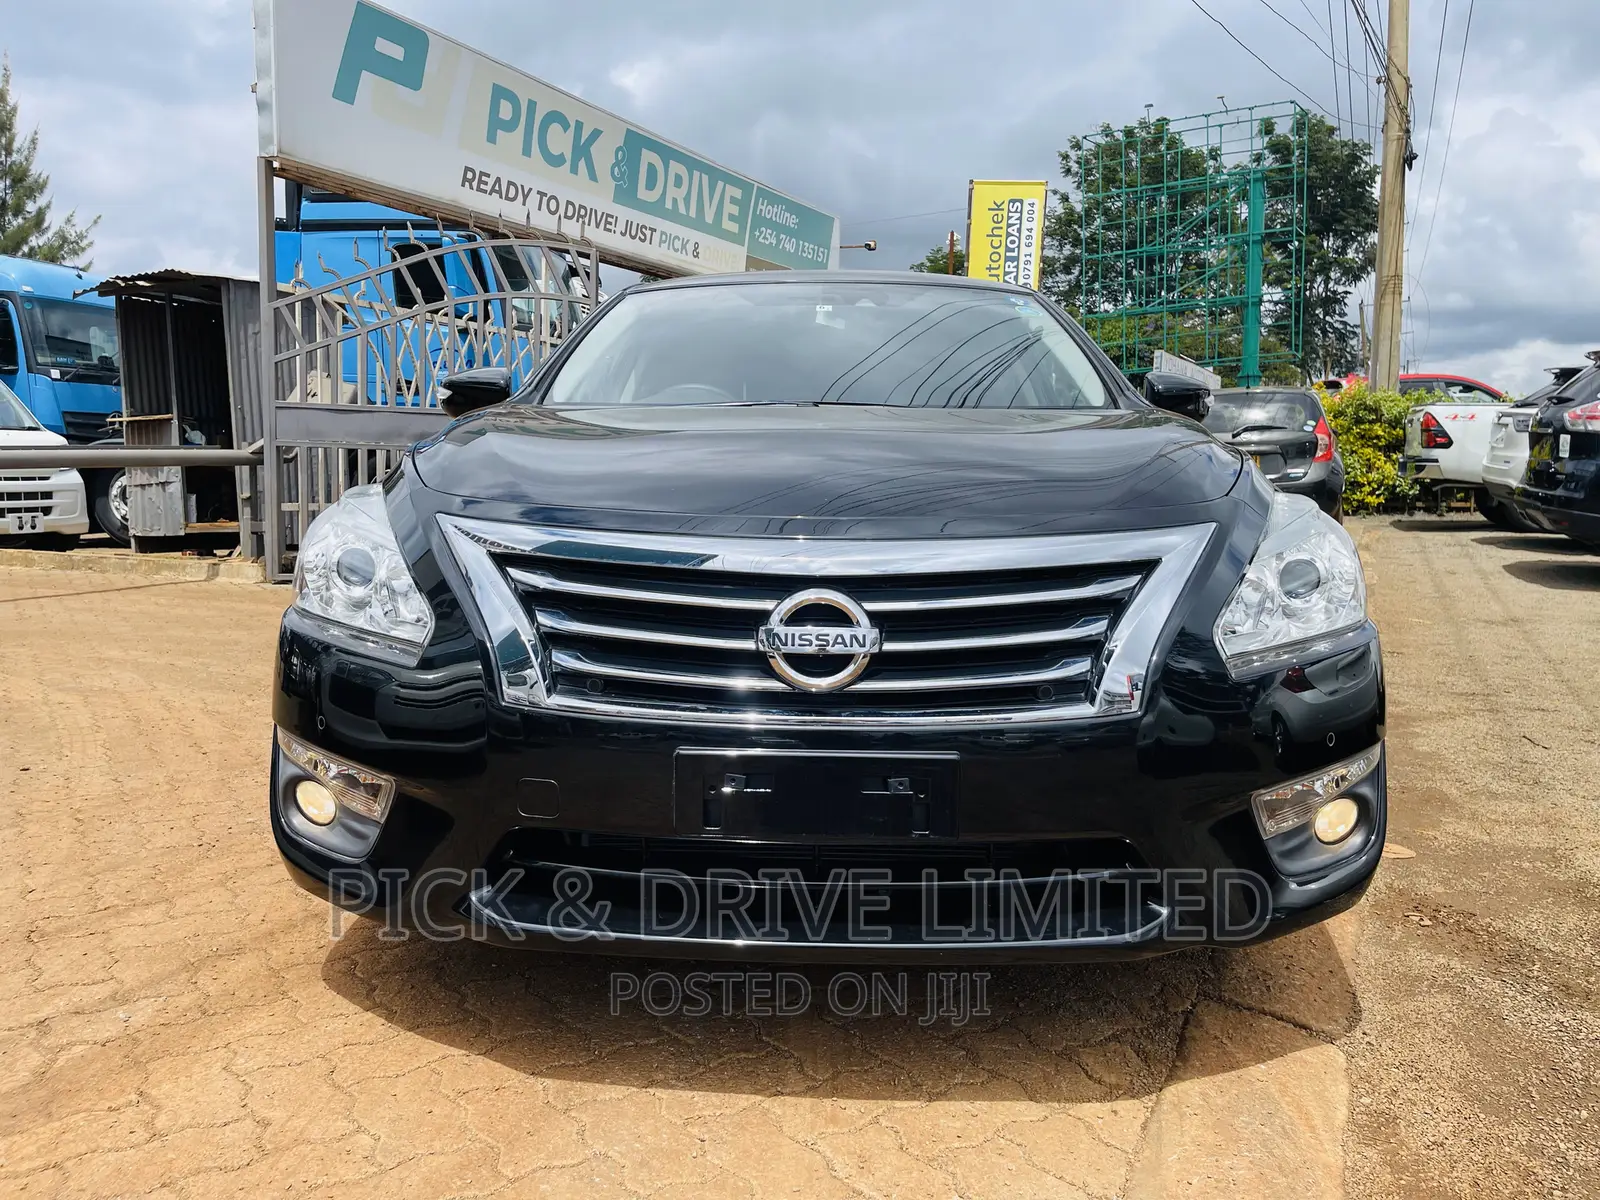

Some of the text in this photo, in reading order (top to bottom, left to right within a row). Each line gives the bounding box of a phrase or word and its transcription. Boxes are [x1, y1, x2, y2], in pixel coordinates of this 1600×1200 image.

[332, 1, 430, 106] P
[486, 82, 743, 234] PICK & DRIVE
[461, 165, 533, 207] READY
[536, 190, 560, 216] TO
[564, 200, 619, 234] DRIVE!
[620, 219, 657, 245] JUST
[658, 230, 691, 257] PICK
[692, 241, 700, 260] &
[754, 227, 828, 263] +254 740 135151
[756, 198, 799, 229] Hotline:
[986, 200, 1005, 282] utochek
[1005, 202, 1022, 285] AR LOANS
[1023, 202, 1035, 280] 0791 694 004
[771, 632, 867, 648] NISSAN
